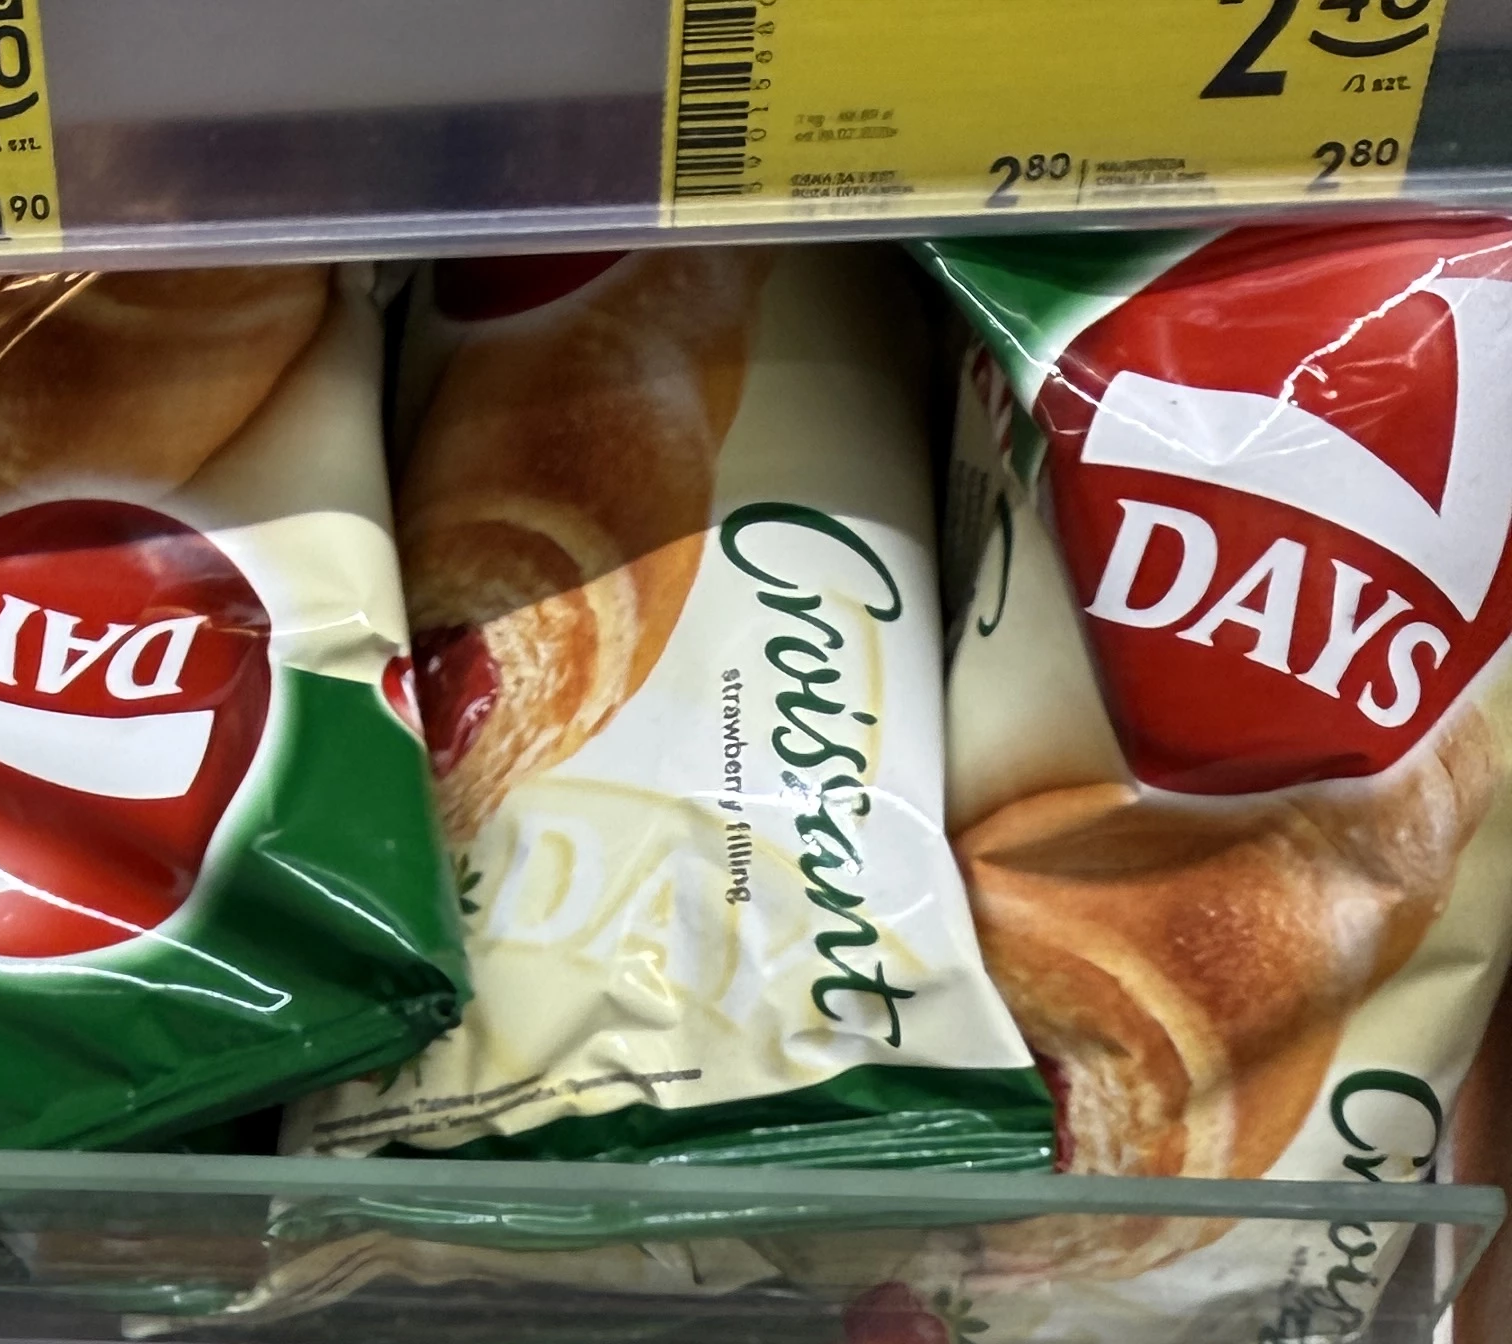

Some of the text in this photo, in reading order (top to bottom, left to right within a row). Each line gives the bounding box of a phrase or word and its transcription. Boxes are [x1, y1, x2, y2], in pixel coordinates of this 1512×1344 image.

[1086, 496, 1451, 729] DAYS
[718, 500, 918, 1049] Croissant
[718, 668, 753, 906] strawberry filling
